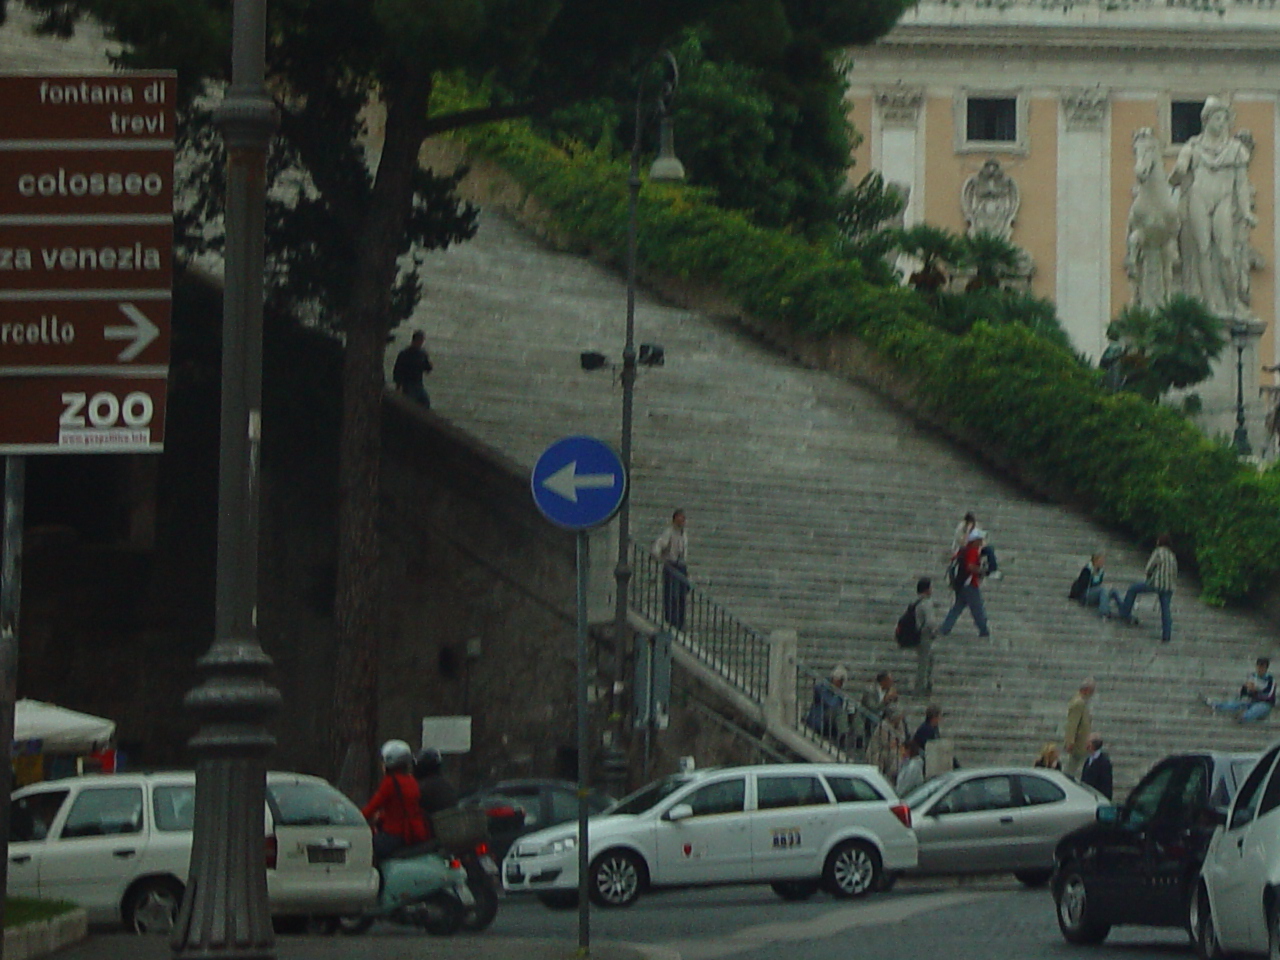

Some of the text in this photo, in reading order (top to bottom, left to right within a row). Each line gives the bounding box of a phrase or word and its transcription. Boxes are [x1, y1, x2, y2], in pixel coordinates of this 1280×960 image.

[40, 80, 166, 104] fontana di
[111, 111, 165, 135] trevi
[18, 167, 163, 196] colosseo
[41, 242, 161, 271] venezia
[1, 314, 75, 345] rcello
